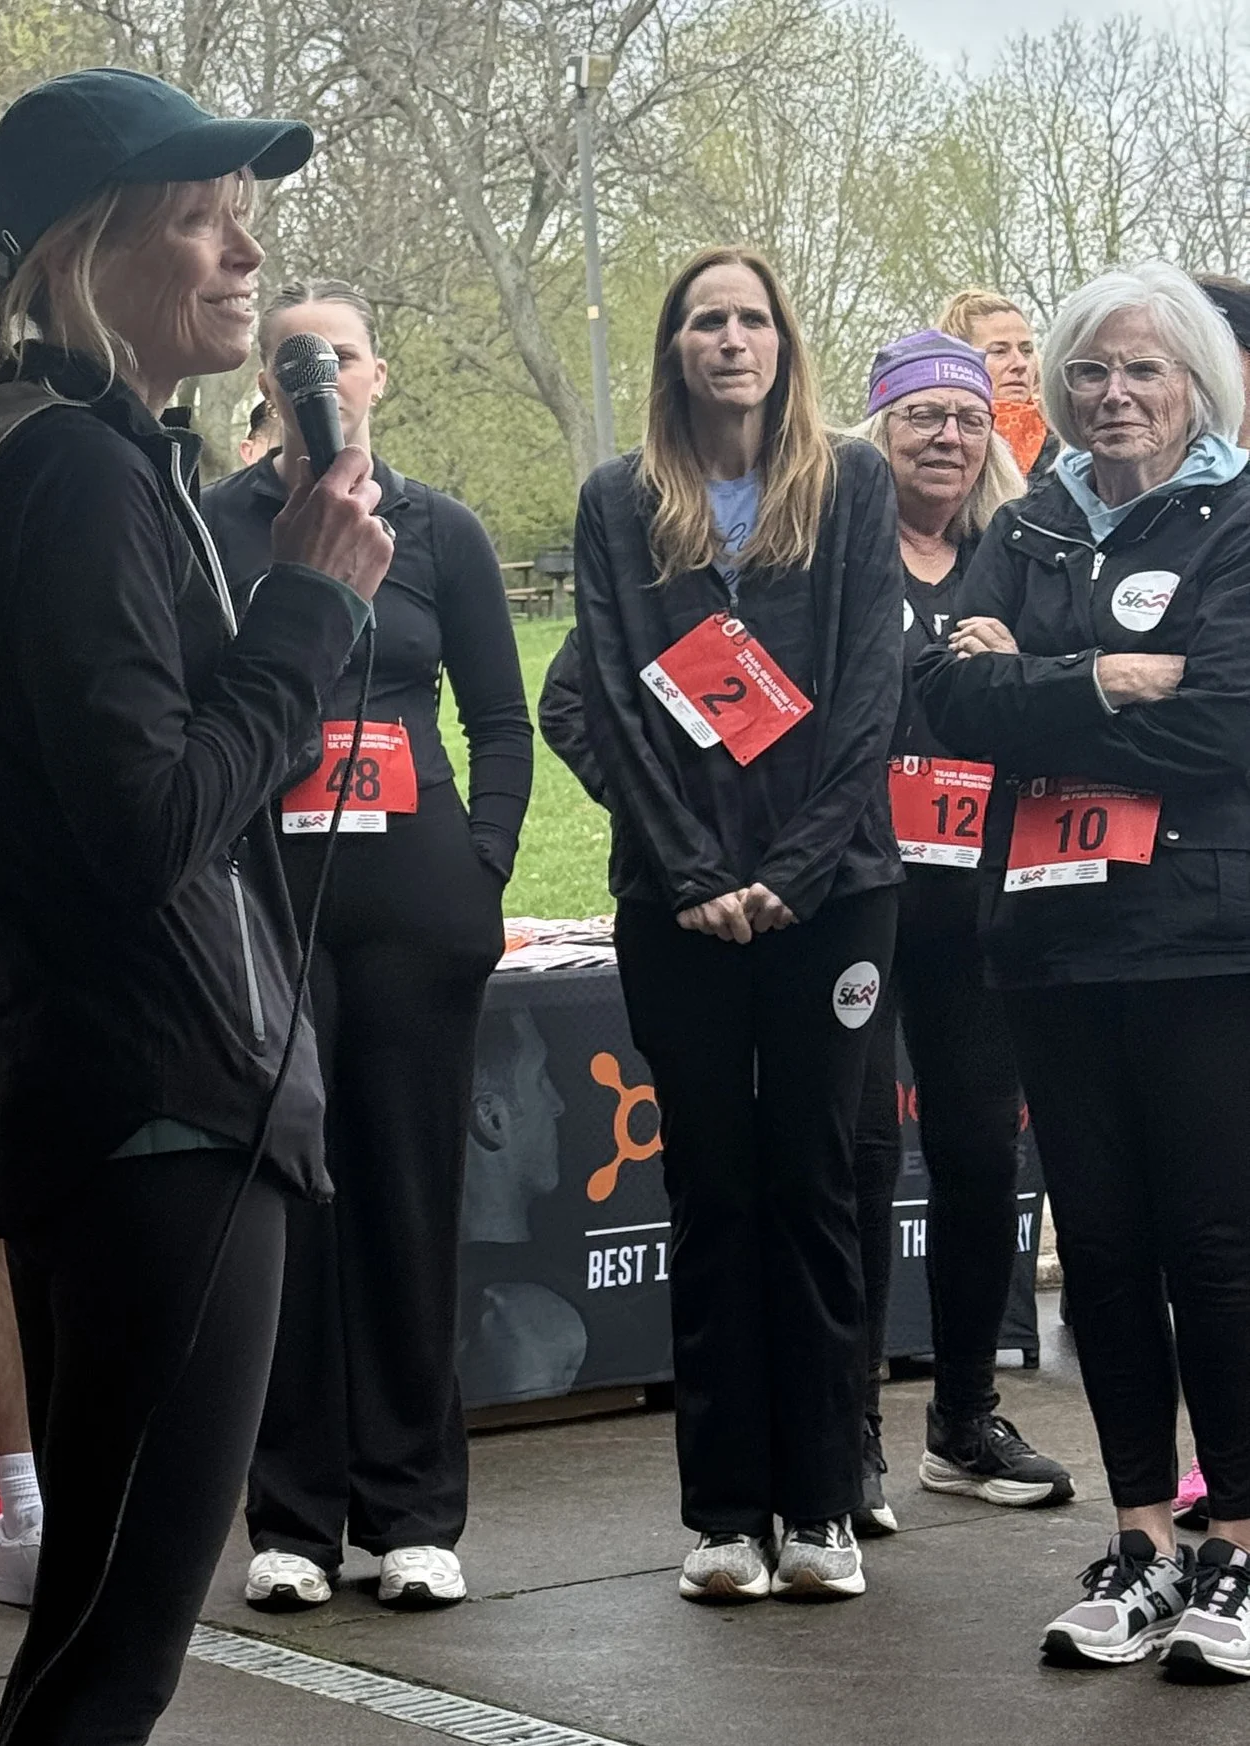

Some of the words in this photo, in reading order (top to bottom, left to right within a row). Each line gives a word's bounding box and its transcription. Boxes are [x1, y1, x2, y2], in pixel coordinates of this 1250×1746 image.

[700, 676, 747, 718] 2
[326, 756, 381, 802] 48
[932, 794, 979, 838] 12
[1055, 806, 1108, 854] 10
[587, 1244, 648, 1290] BEST
[900, 1219, 927, 1258] TH
